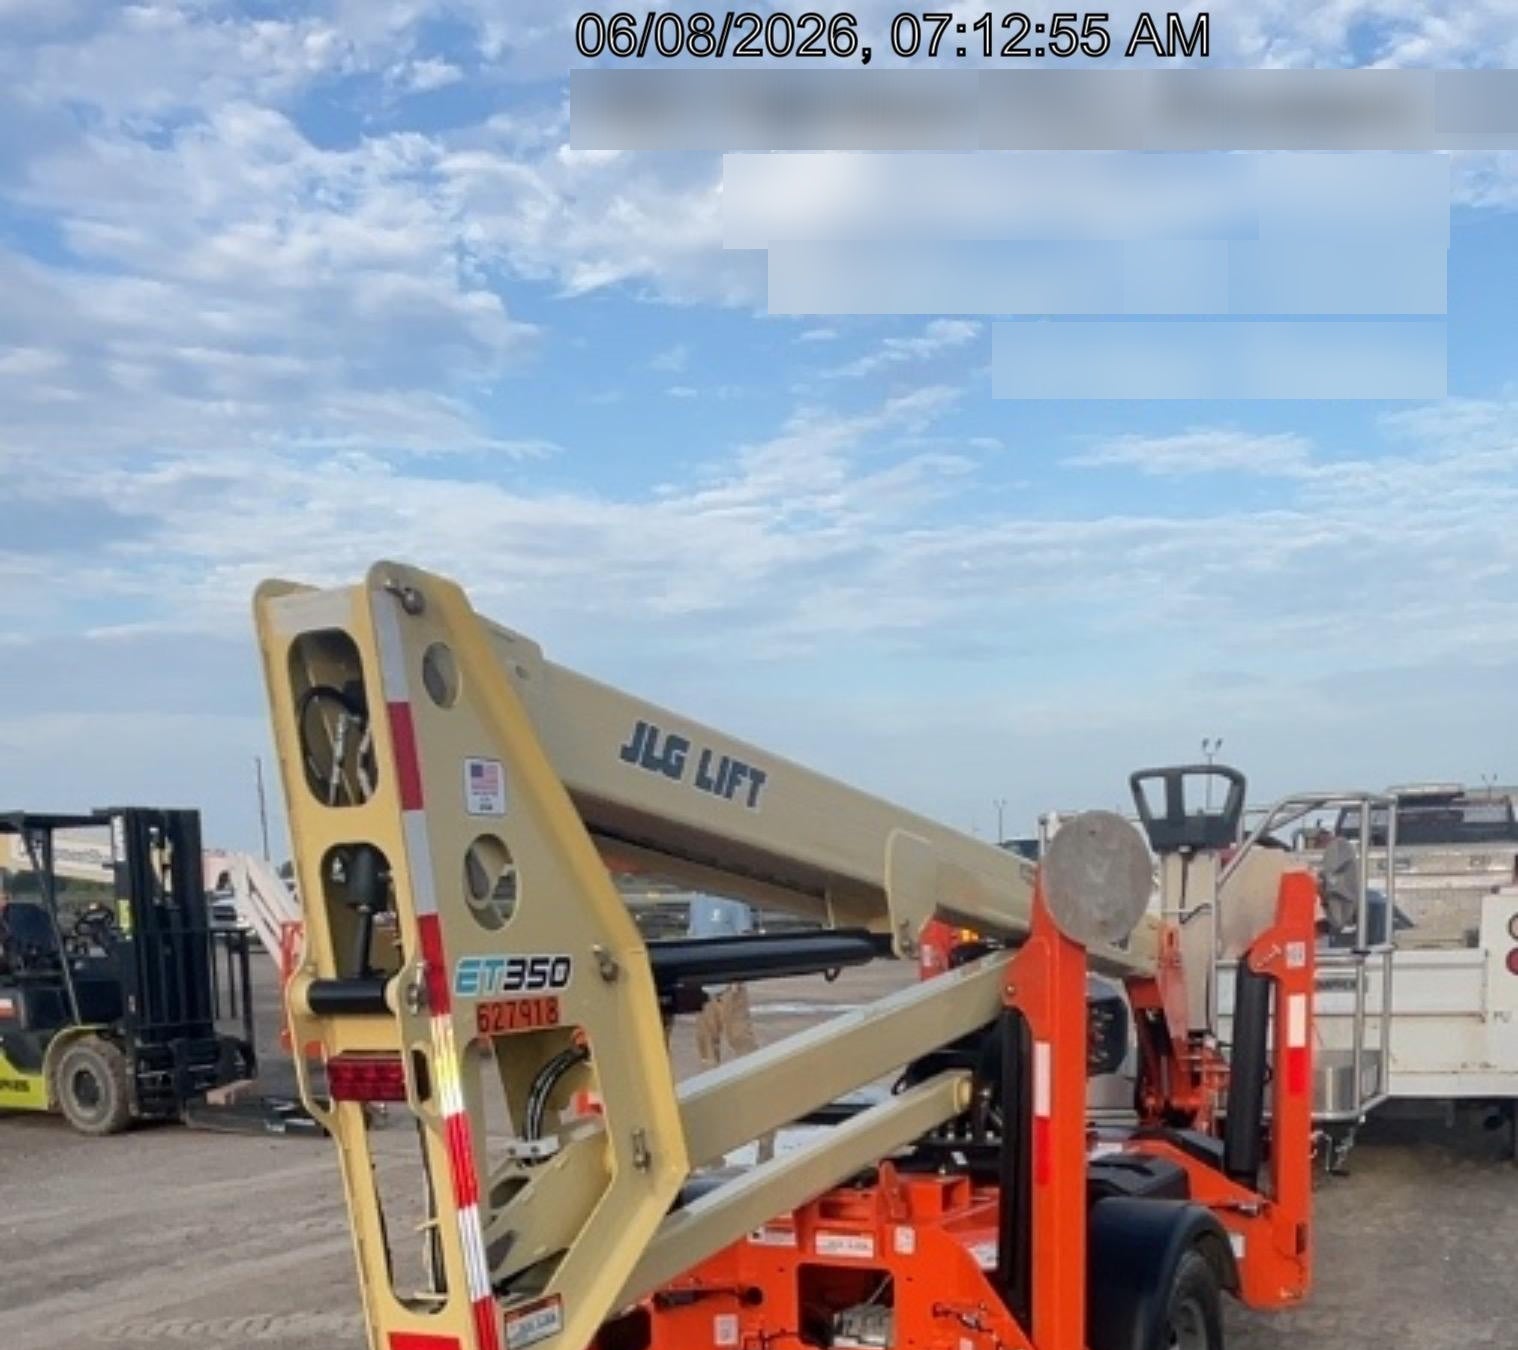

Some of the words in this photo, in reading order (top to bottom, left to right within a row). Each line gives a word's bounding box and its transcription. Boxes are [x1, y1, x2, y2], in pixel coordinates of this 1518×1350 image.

[620, 719, 691, 781] JLG
[693, 747, 767, 808] LIFT
[455, 956, 571, 994] ET350
[477, 997, 559, 1033] 627918
